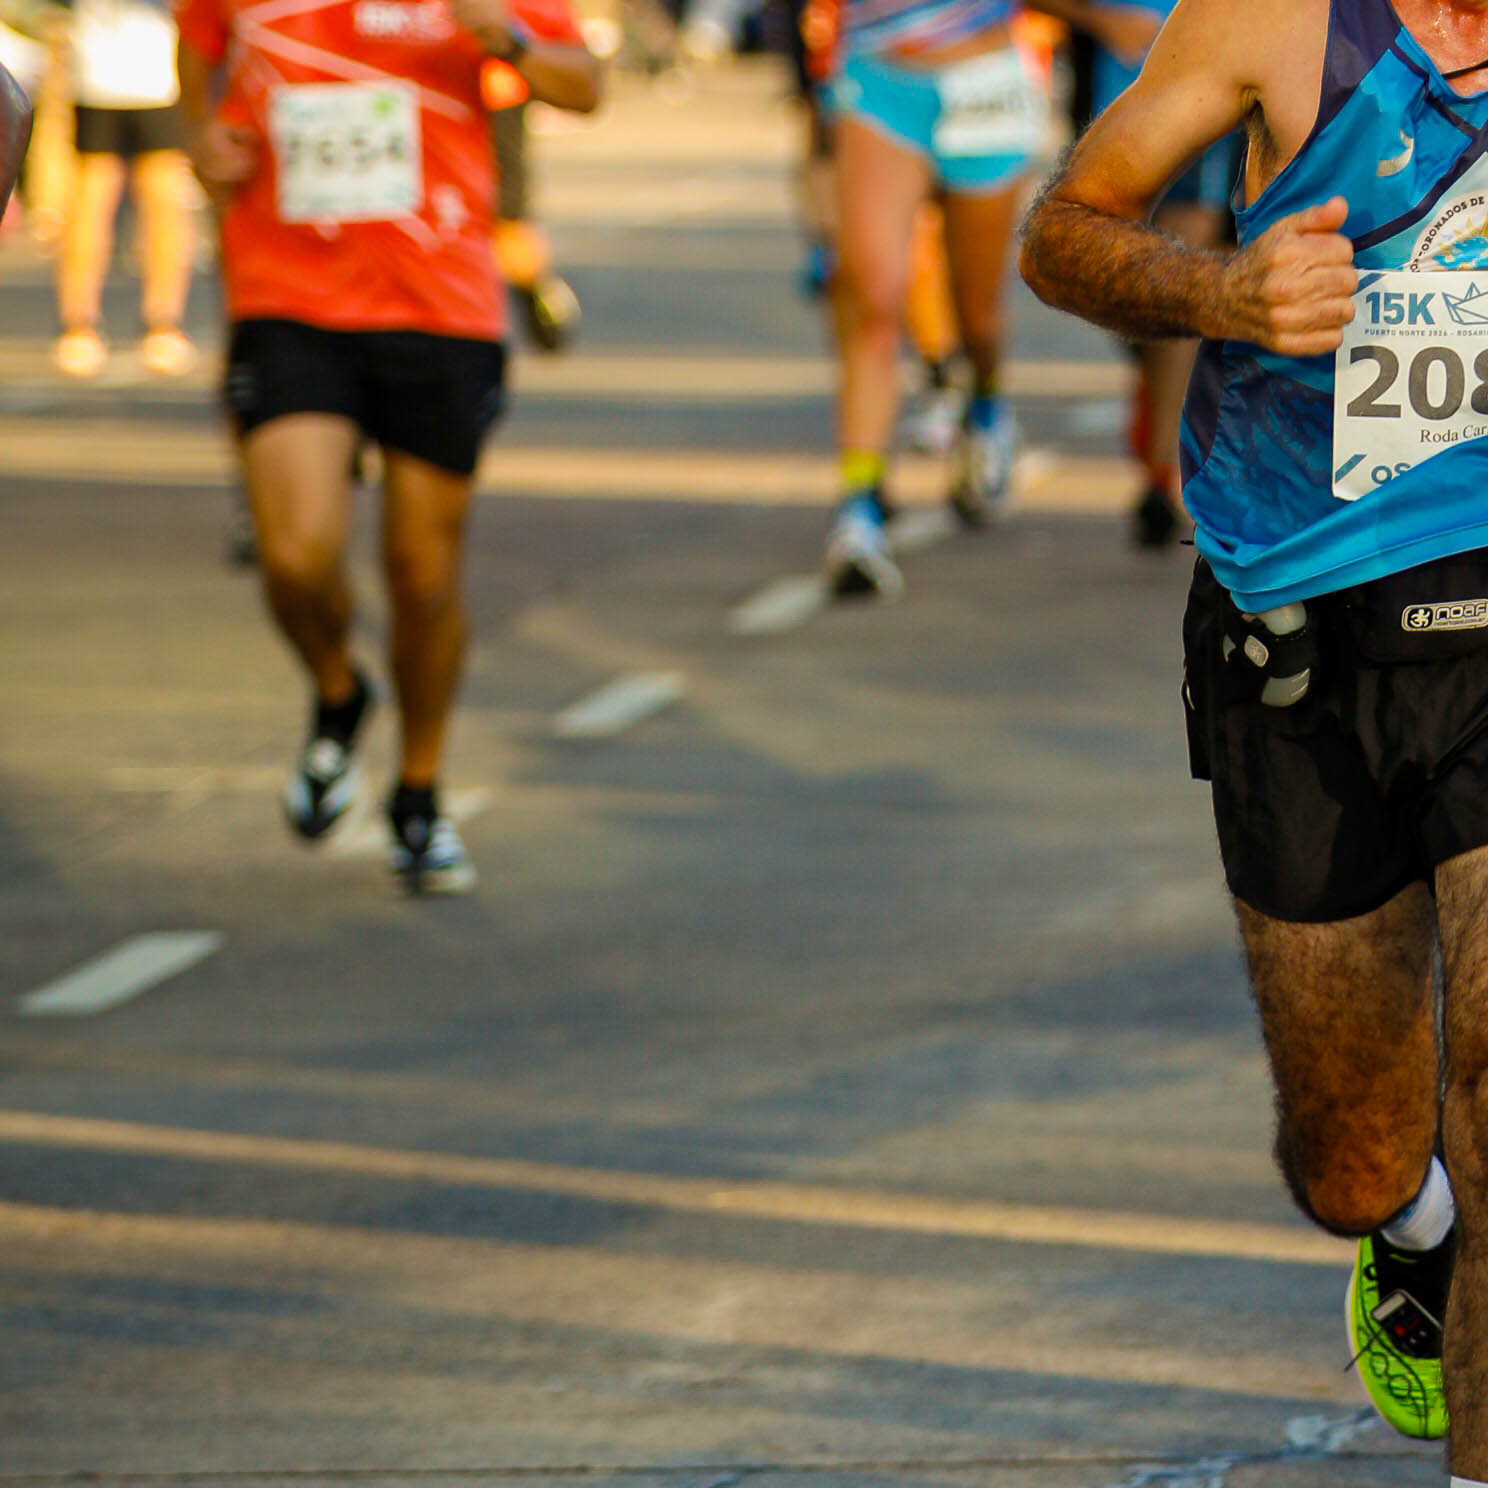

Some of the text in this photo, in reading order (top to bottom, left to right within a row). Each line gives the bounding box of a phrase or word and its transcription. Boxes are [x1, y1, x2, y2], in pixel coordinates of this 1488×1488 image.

[1470, 196, 1485, 206] DE
[1365, 291, 1436, 326] 15K
[1364, 328, 1396, 337] PUERTO
[1399, 329, 1425, 337] NORTE
[1420, 429, 1459, 443] Roda
